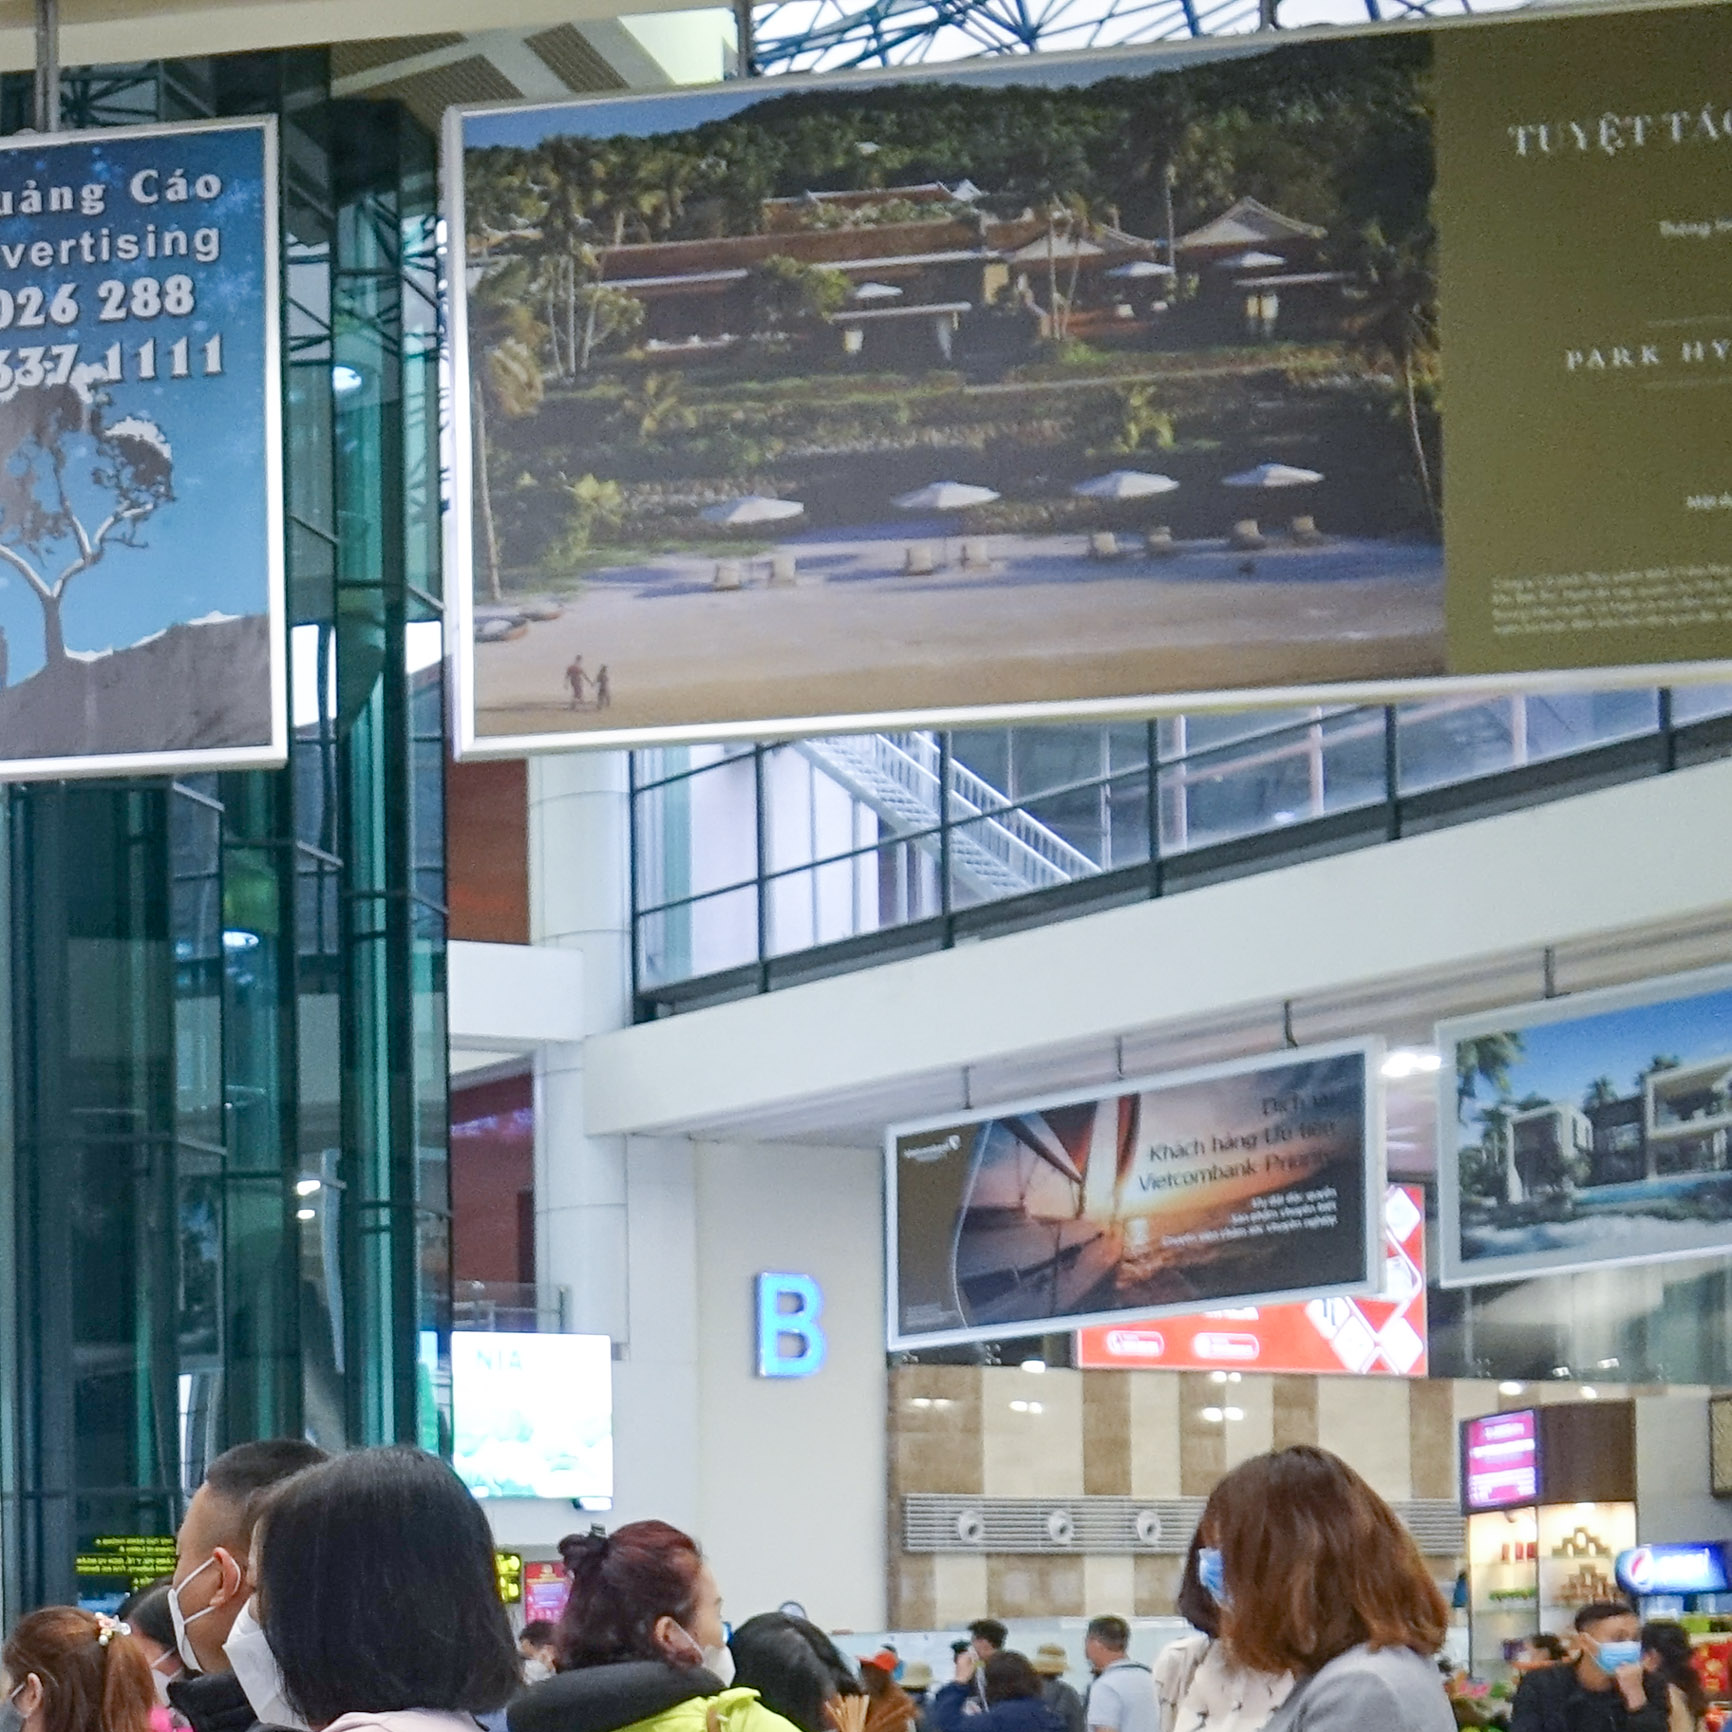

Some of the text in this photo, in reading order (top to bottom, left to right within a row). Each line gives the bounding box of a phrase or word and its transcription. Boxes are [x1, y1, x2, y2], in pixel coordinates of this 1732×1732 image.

[130, 168, 222, 204] Cáo
[98, 274, 195, 321] 288
[103, 333, 223, 383] 1111
[1566, 345, 1660, 370] PARK
[1138, 1157, 1257, 1192] Vietcombank
[755, 1272, 827, 1378] B
